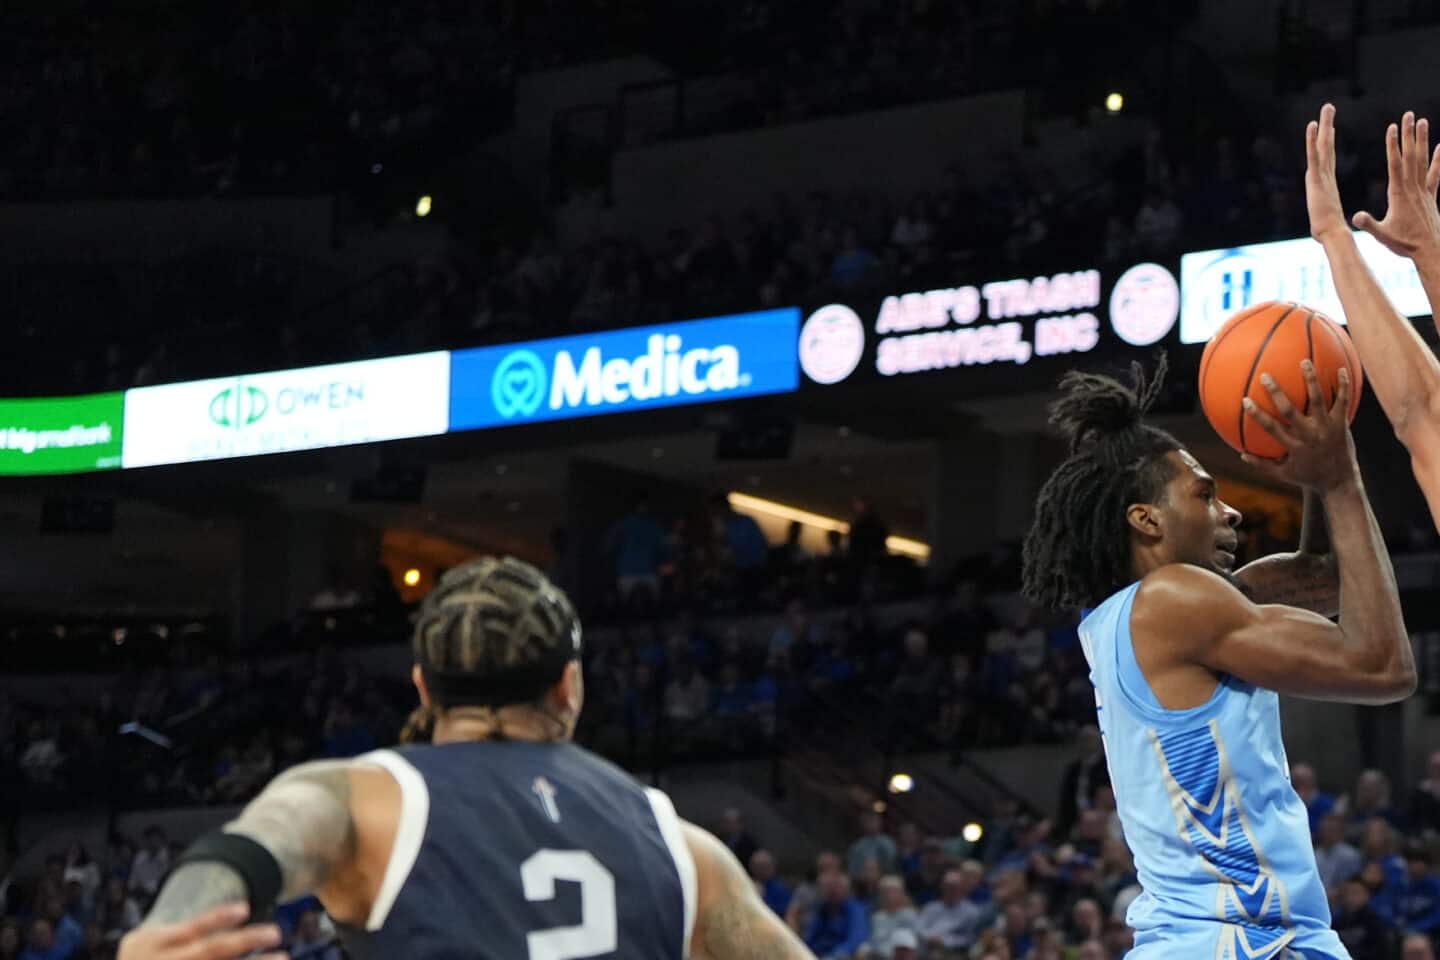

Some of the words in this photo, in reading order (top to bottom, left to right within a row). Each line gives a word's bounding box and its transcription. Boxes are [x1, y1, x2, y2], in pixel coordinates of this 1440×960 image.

[982, 269, 1100, 320] TRASH
[1035, 312, 1100, 356] INC
[548, 334, 739, 410] Medica
[276, 381, 365, 416] OWEN
